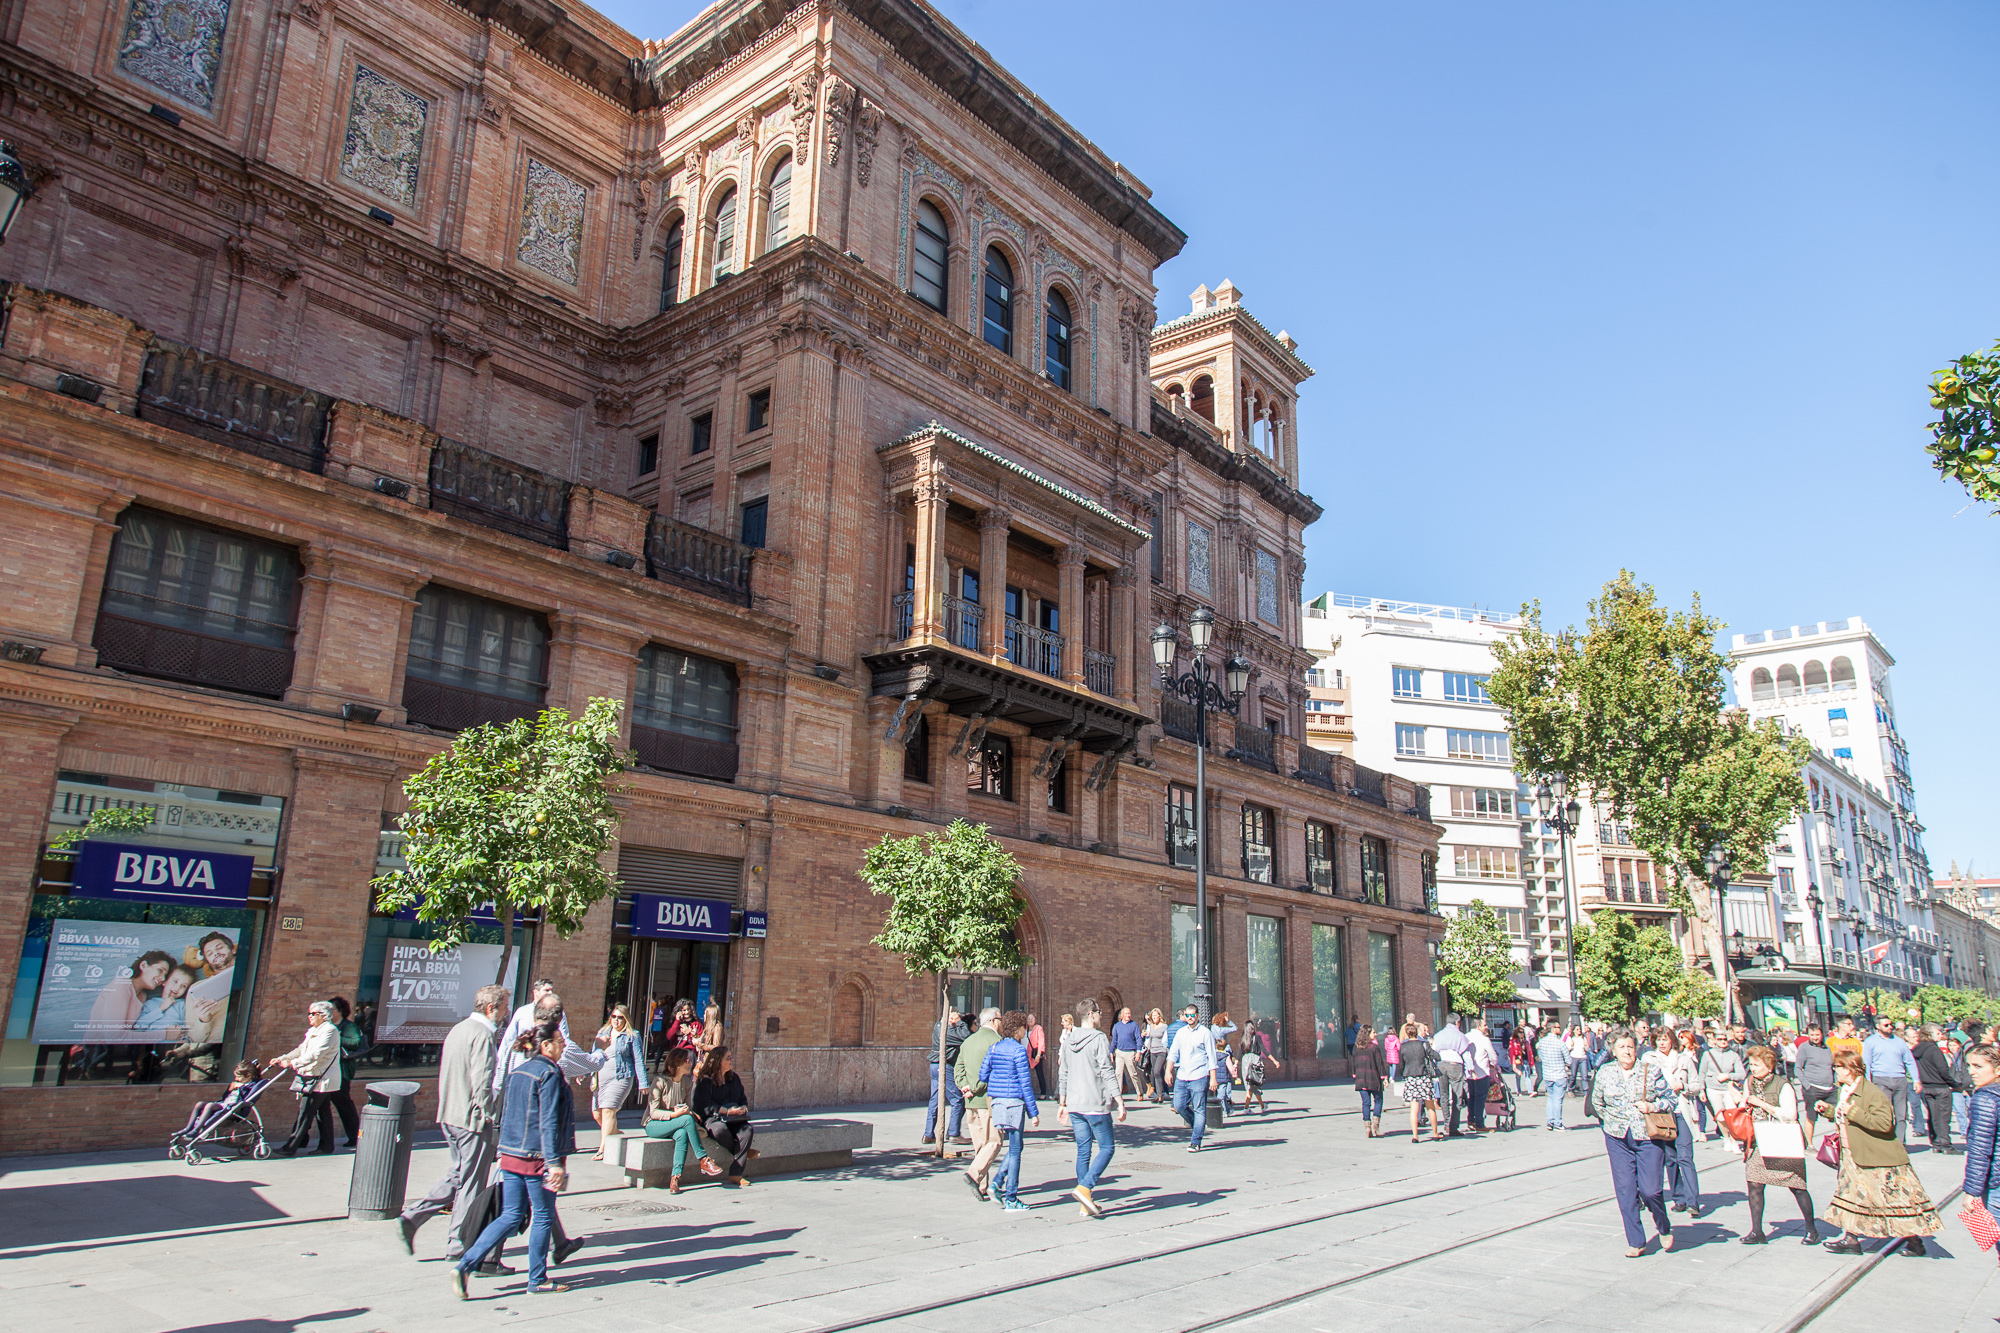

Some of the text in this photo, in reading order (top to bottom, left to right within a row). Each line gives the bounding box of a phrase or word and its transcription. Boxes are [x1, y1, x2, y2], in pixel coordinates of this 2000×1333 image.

[1756, 689, 1858, 711] AXA SEGUROS
[115, 852, 215, 889] BBVA
[657, 901, 712, 928] BBVA
[749, 916, 765, 925] BBVA
[283, 918, 295, 929] 38
[58, 933, 140, 946] BBVA VALORA
[391, 959, 461, 975] FIJA BBVA
[442, 980, 460, 991] TIN
